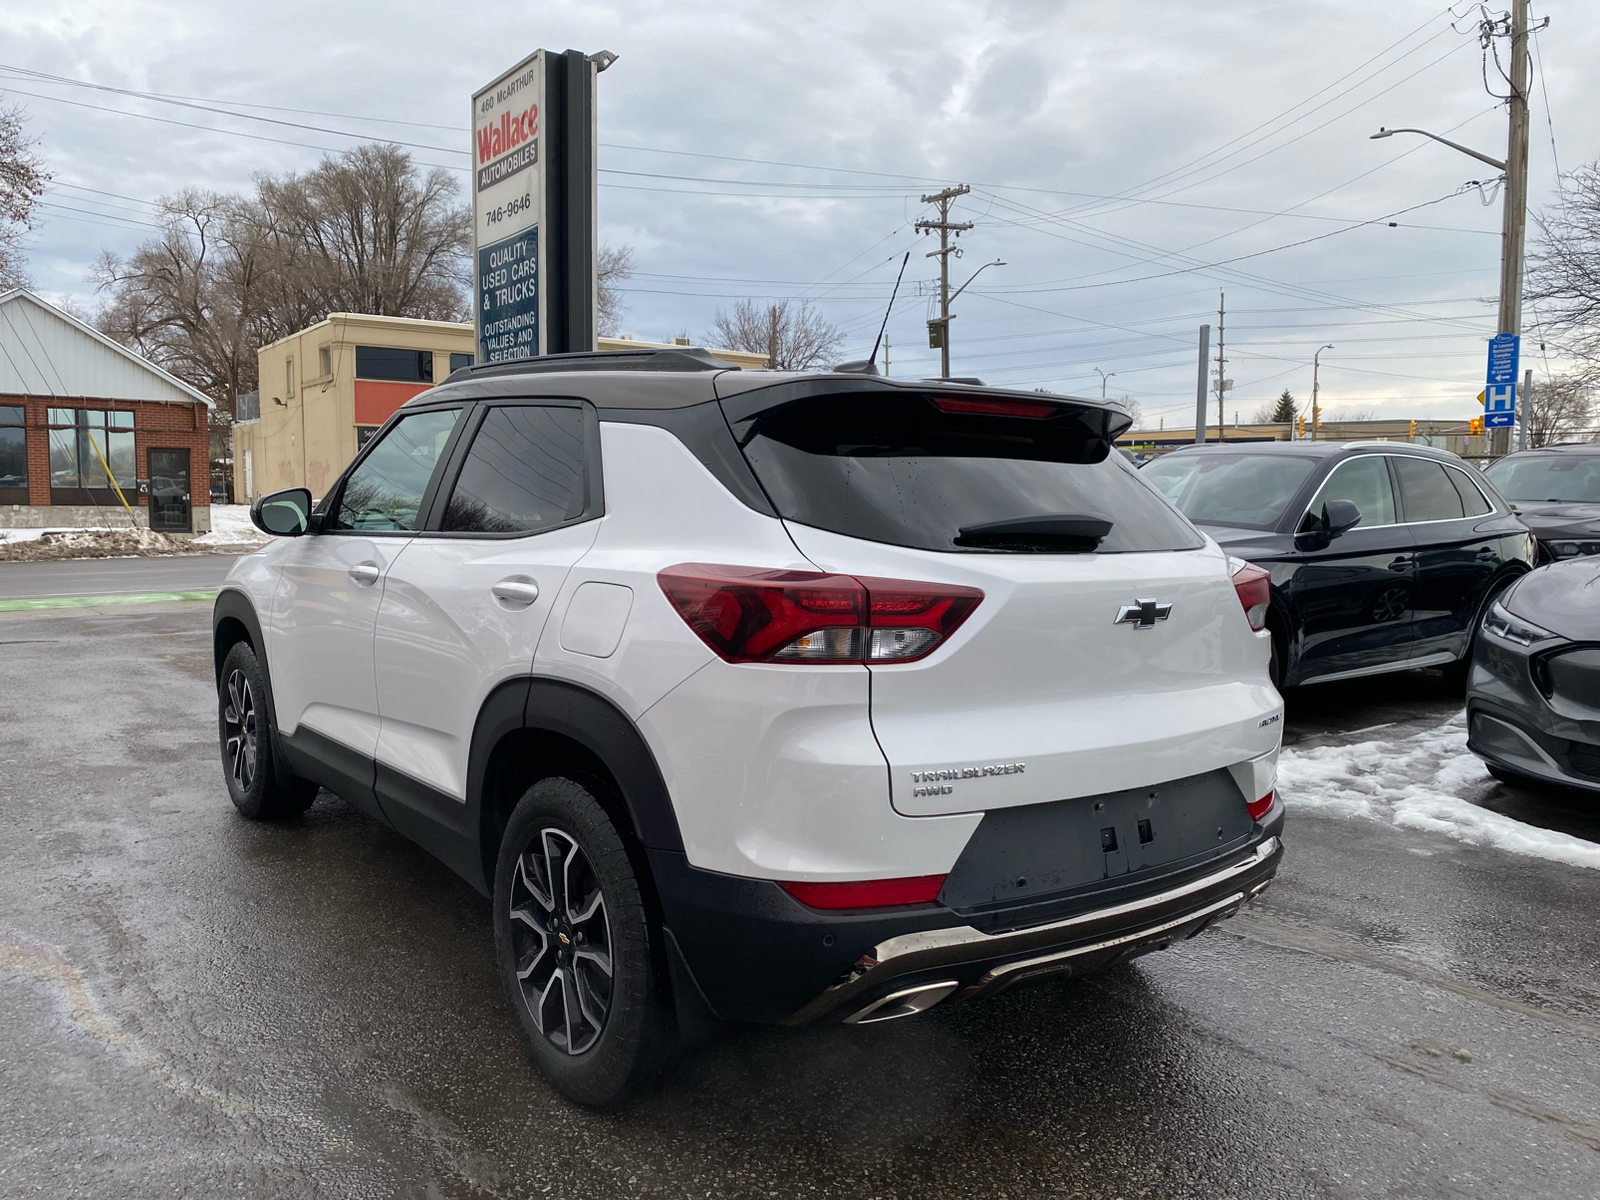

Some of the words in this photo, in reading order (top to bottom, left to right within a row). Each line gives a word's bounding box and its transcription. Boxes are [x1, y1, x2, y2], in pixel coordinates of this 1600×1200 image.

[481, 96, 494, 114] 460
[497, 69, 534, 104] McARTHUR
[477, 103, 538, 164] Wallace
[481, 143, 535, 187] AUTOMOBILES
[486, 193, 530, 227] 746-9646
[490, 240, 527, 268] QUALITY
[482, 270, 507, 290] USED
[511, 257, 535, 281] CARS
[483, 294, 490, 310] &
[495, 279, 535, 307] TRUCKS
[485, 311, 534, 337] OUTSTANDING
[487, 332, 514, 350] VALUES
[517, 328, 532, 344] AND
[1489, 386, 1512, 410] H
[911, 763, 1025, 783] TRAILBLAZER
[913, 784, 953, 797] AWD
